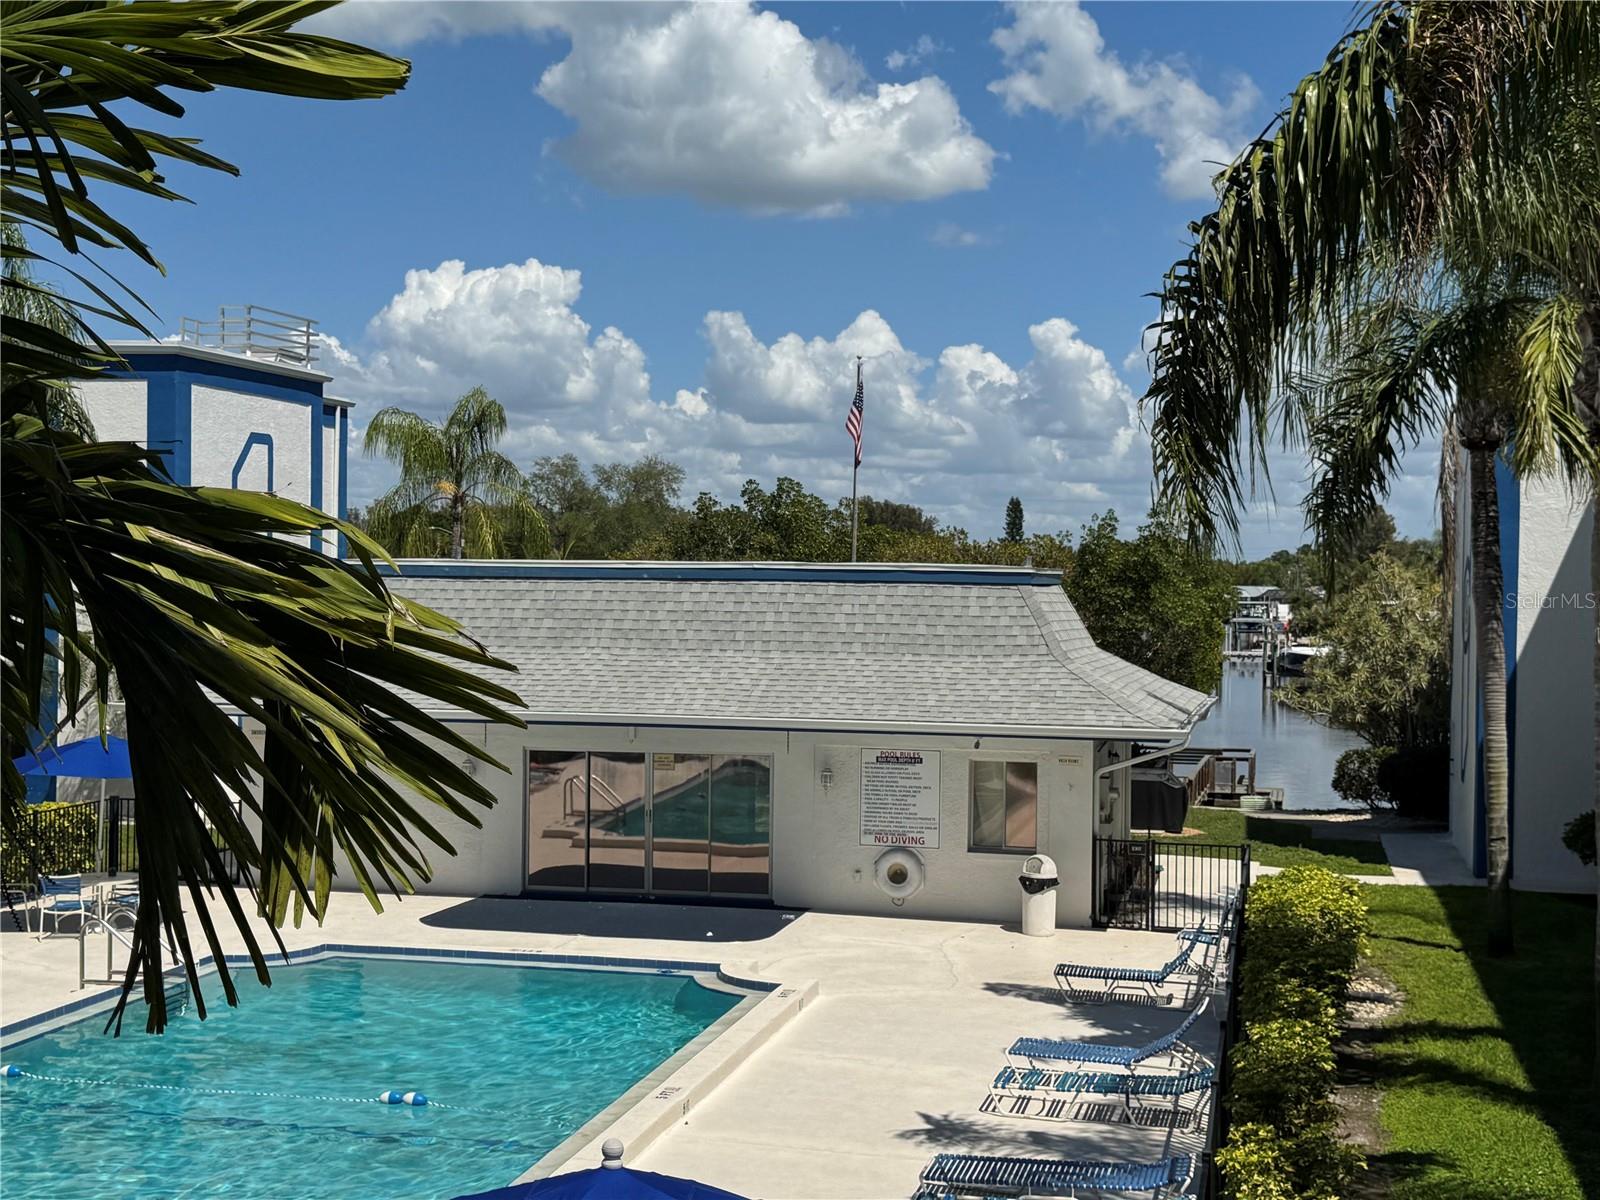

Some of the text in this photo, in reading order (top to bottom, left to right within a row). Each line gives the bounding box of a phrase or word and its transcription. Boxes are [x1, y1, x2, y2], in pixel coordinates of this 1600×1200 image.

[900, 751, 920, 759] RULES
[874, 836, 925, 845] NO DIVING
